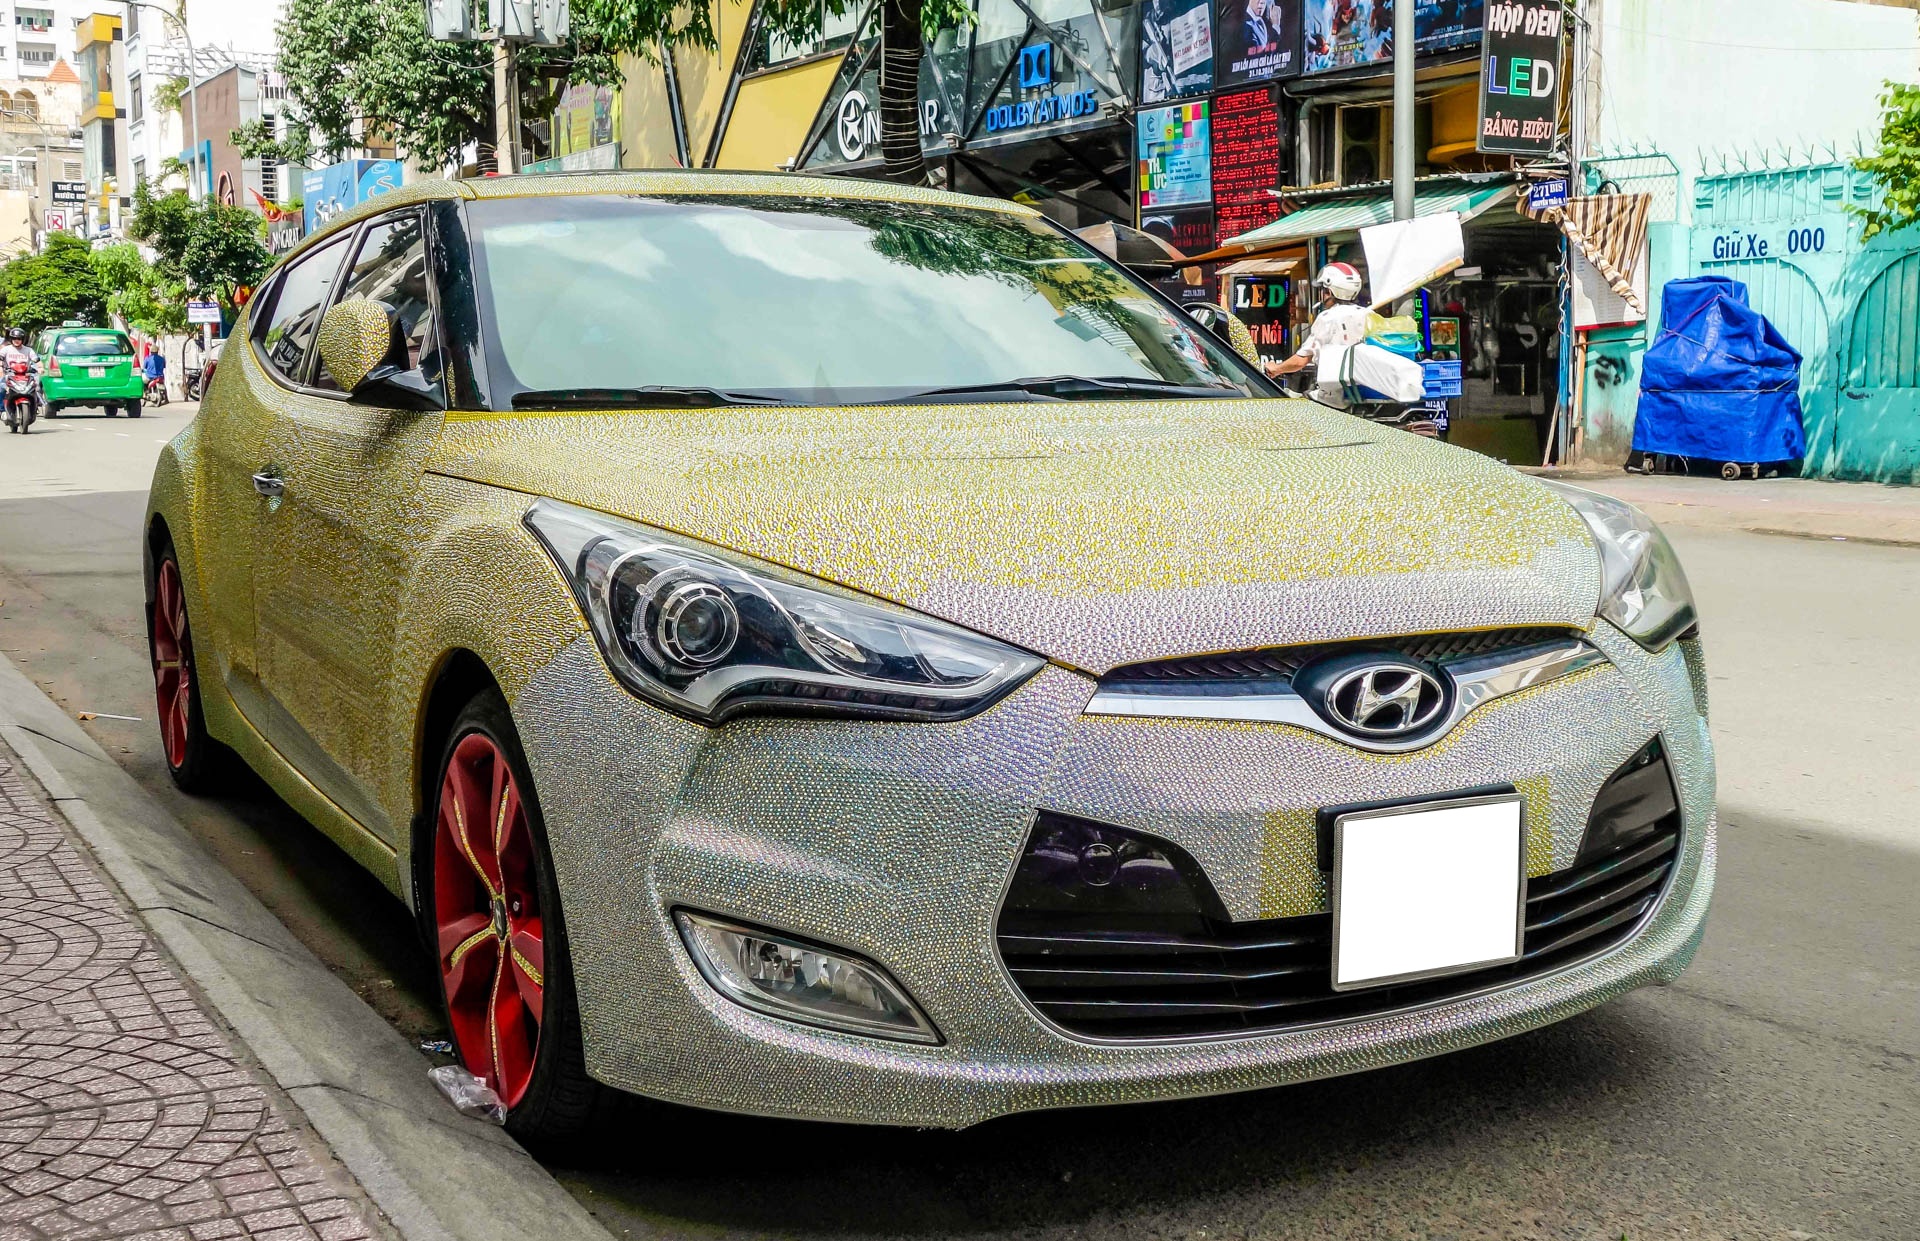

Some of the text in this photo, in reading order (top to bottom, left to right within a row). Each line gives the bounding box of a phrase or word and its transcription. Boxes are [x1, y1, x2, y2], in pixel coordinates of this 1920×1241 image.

[1488, 0, 1561, 38] HỘP ĐÈN
[1488, 56, 1555, 98] LED
[986, 88, 1098, 132] DOLBY ATMOS
[1483, 111, 1554, 143] BẢNG HIỆU
[1533, 182, 1563, 198] 271 BIS
[1713, 230, 1743, 259] Giữ
[1746, 233, 1768, 257] Xe
[1236, 284, 1286, 308] LED
[1261, 319, 1282, 345] Nổi
